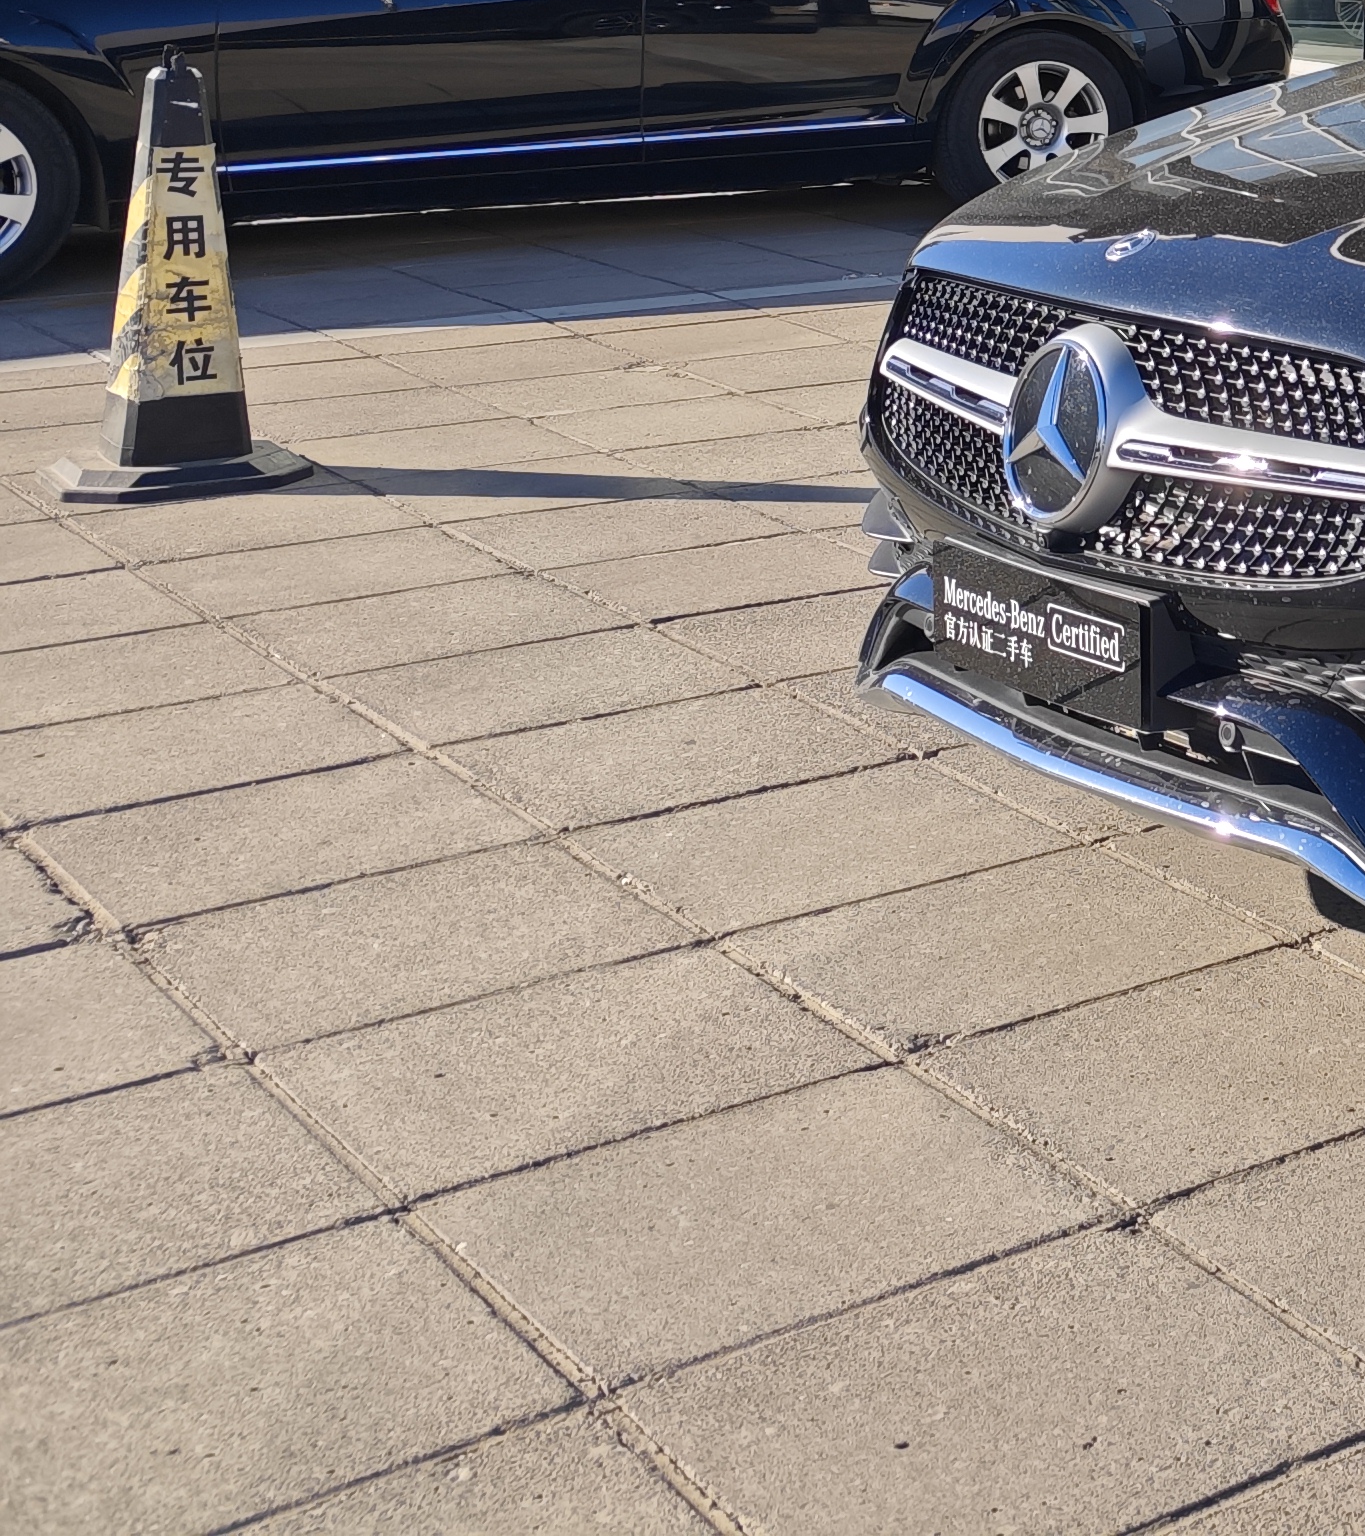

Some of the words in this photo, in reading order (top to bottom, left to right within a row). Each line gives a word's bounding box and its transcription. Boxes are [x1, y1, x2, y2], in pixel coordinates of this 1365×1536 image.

[156, 151, 217, 386] 专用车位
[943, 575, 1046, 638] Mercedes-Benz
[1051, 614, 1120, 663] Certified
[943, 612, 1033, 668] 官方认证二手车
